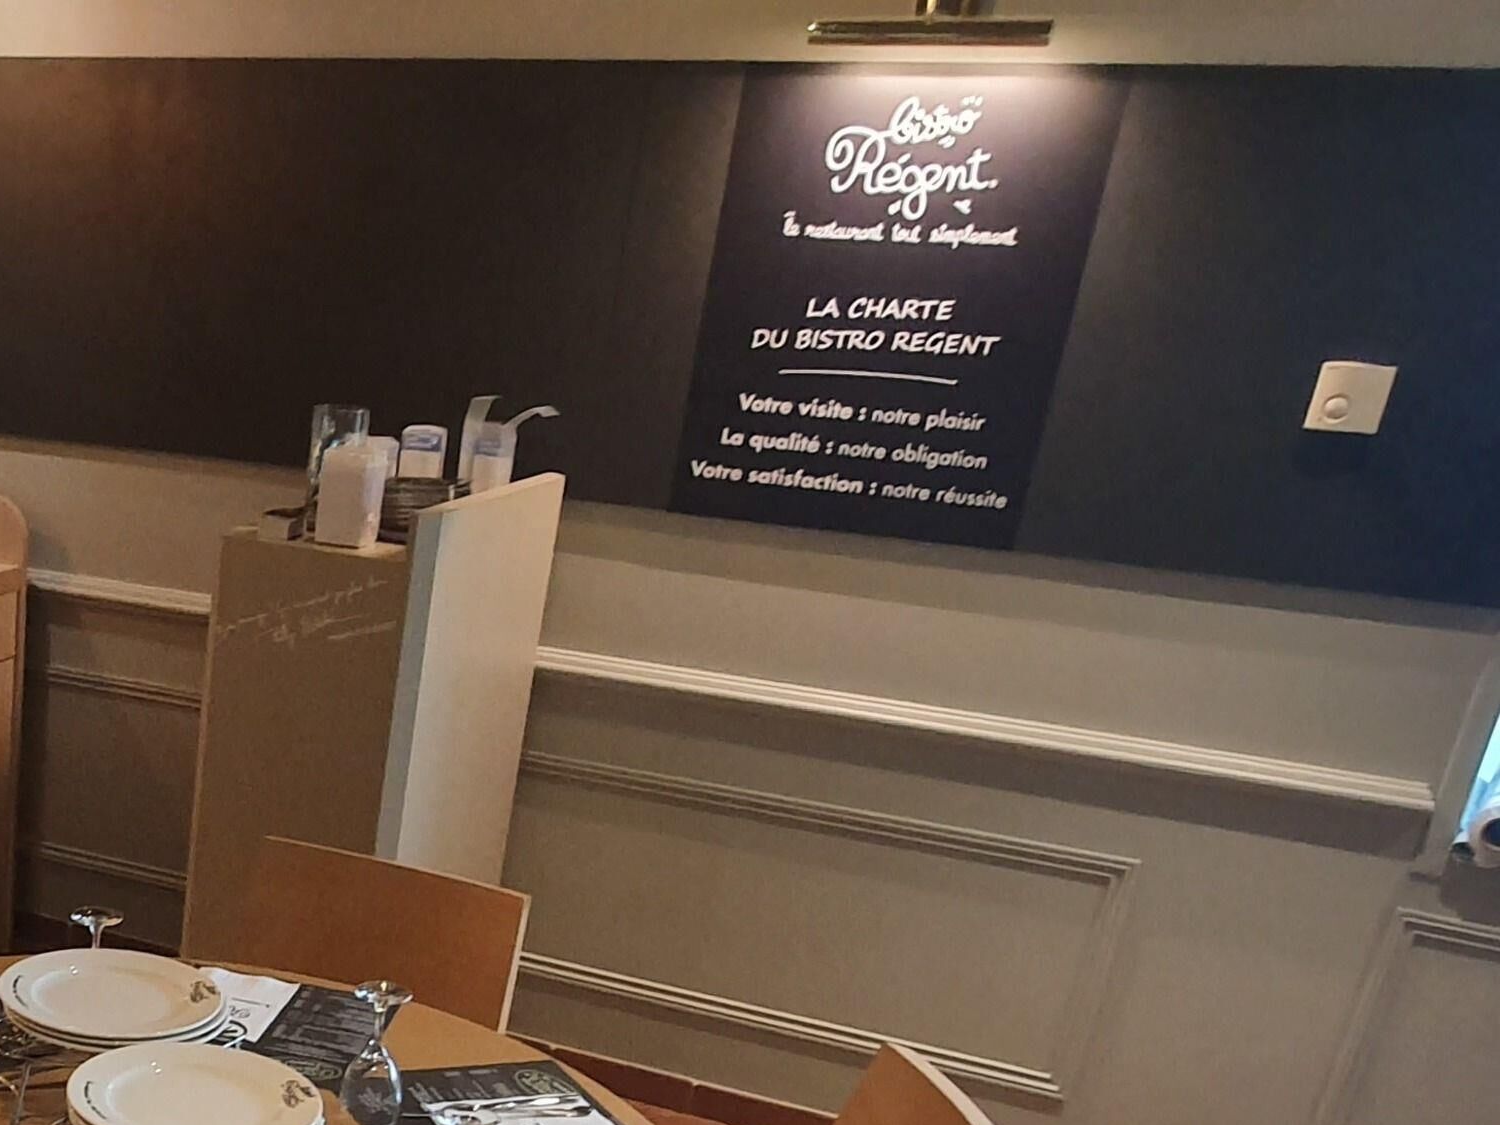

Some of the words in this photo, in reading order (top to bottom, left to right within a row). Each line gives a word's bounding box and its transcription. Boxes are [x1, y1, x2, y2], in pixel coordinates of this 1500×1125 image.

[805, 297, 840, 319] LA
[847, 296, 957, 321] CHARTE
[750, 328, 789, 350] DU
[794, 328, 886, 352] BISTRO
[890, 331, 1001, 357] REGENT
[738, 392, 794, 416] Votre
[798, 397, 854, 421] visite
[871, 407, 921, 427] notre
[924, 407, 987, 433] plaisir
[719, 427, 745, 447] La
[748, 431, 822, 457] qualité
[838, 442, 887, 461] notre
[891, 442, 988, 471] obligation
[690, 459, 743, 482] Votre
[746, 466, 864, 495] satisfaction
[881, 482, 931, 502] notre
[935, 485, 1009, 511] réussite
